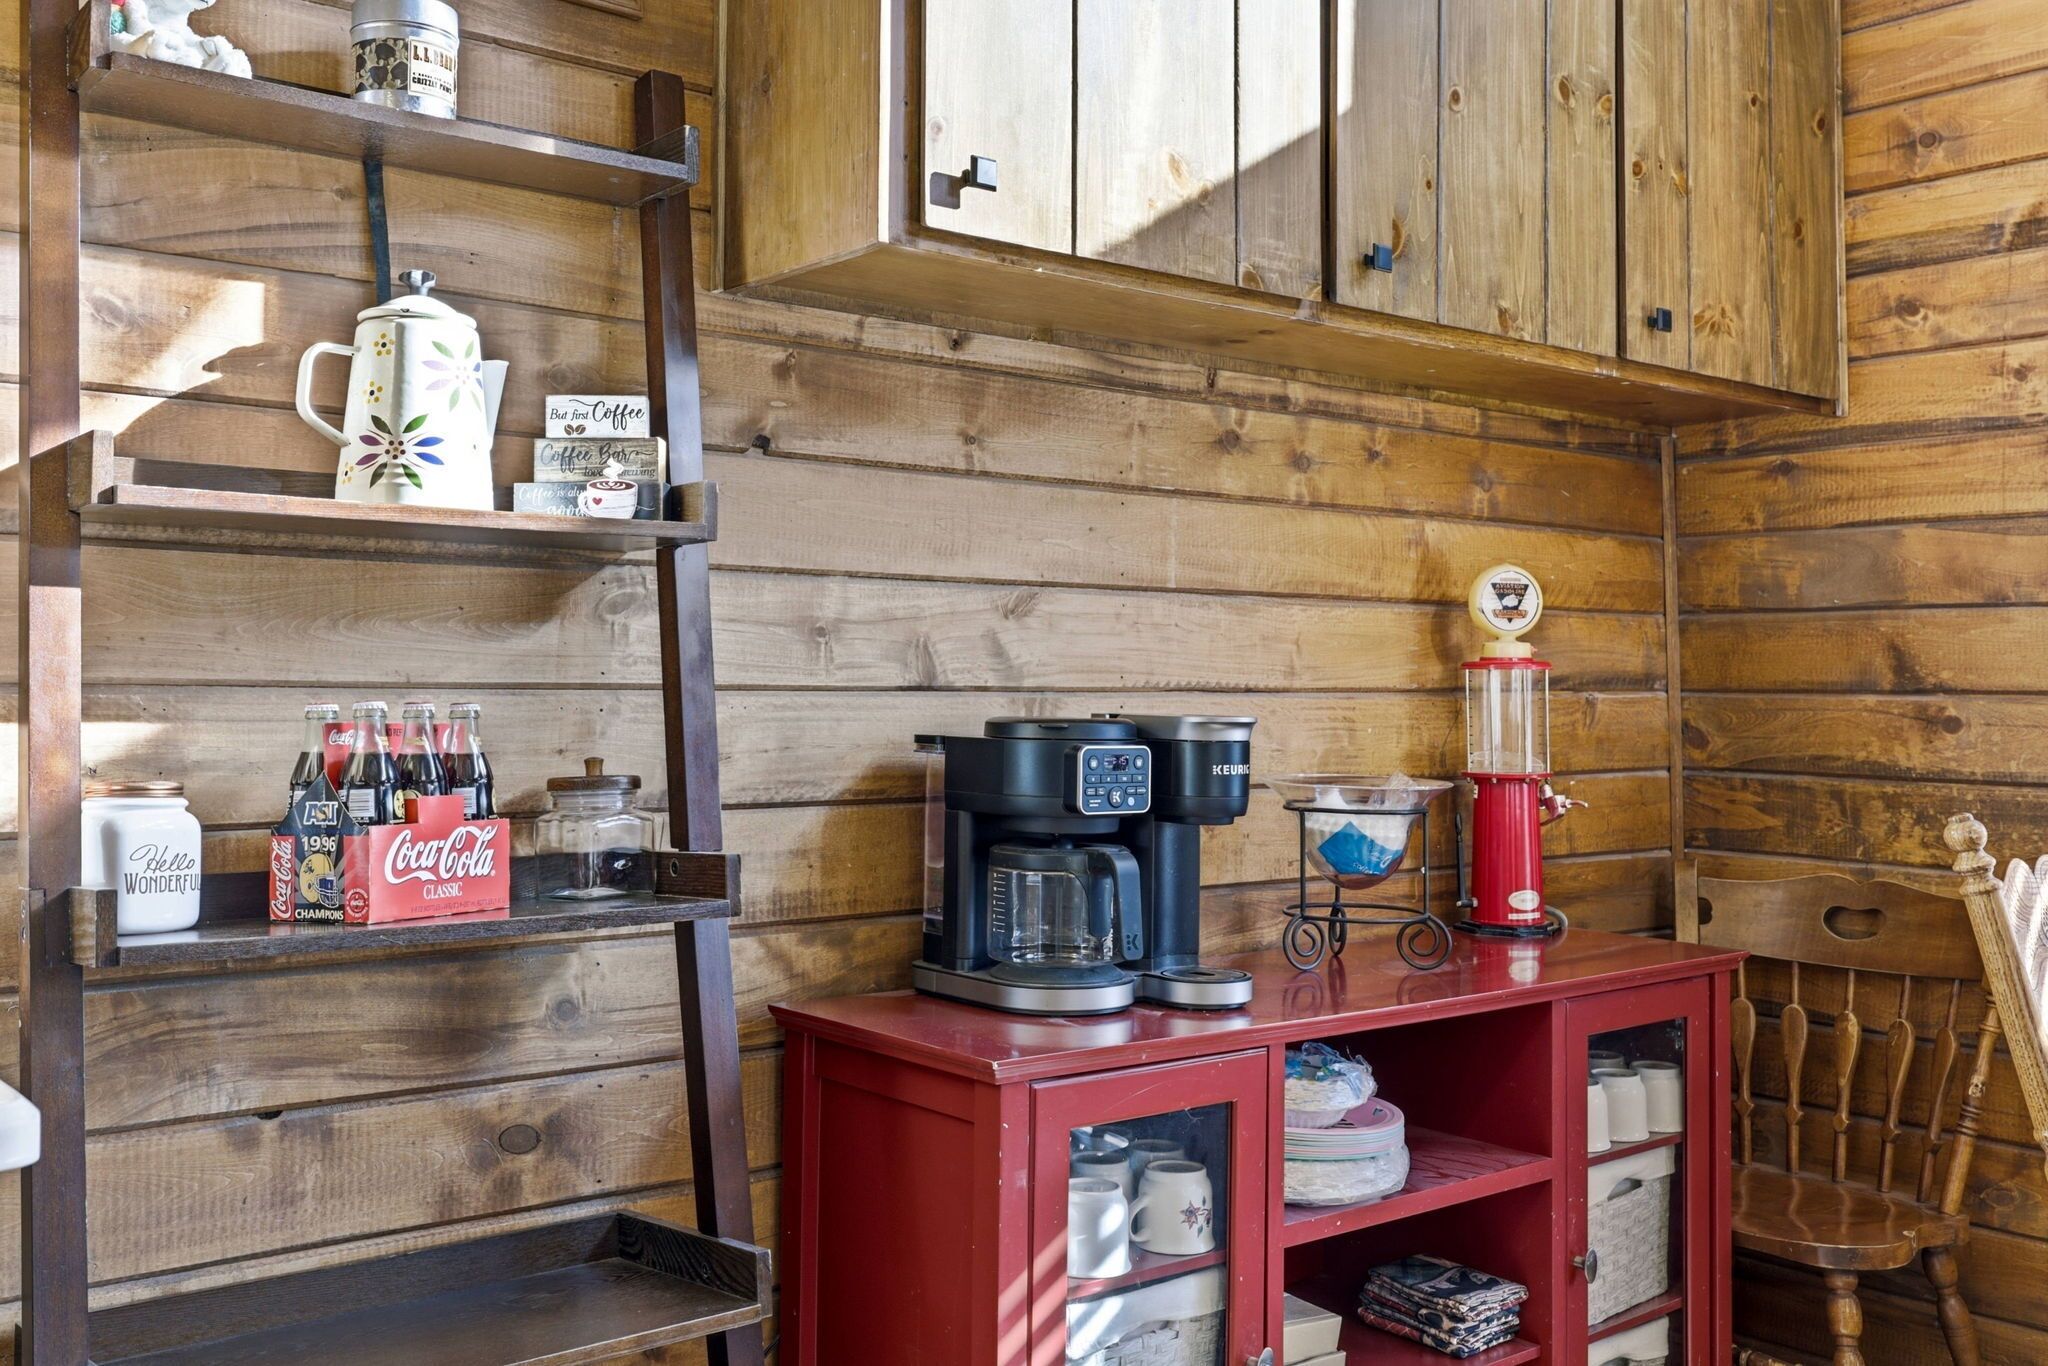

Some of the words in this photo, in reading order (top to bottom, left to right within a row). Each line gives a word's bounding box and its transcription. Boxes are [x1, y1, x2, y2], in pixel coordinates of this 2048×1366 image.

[550, 408, 568, 420] But
[571, 409, 589, 421] first
[575, 400, 645, 431] Coffee
[541, 443, 592, 474] Coffee
[599, 442, 646, 465] Bar
[520, 486, 555, 506] Coffee
[301, 835, 336, 852] 1996
[384, 824, 499, 884] Coca-Cola
[129, 844, 196, 874] Hello
[124, 872, 201, 895] WONDERFUL
[272, 838, 292, 919] Coca-Cola
[423, 882, 463, 900] CLASSIC
[294, 908, 344, 920] CHAMPIONS
